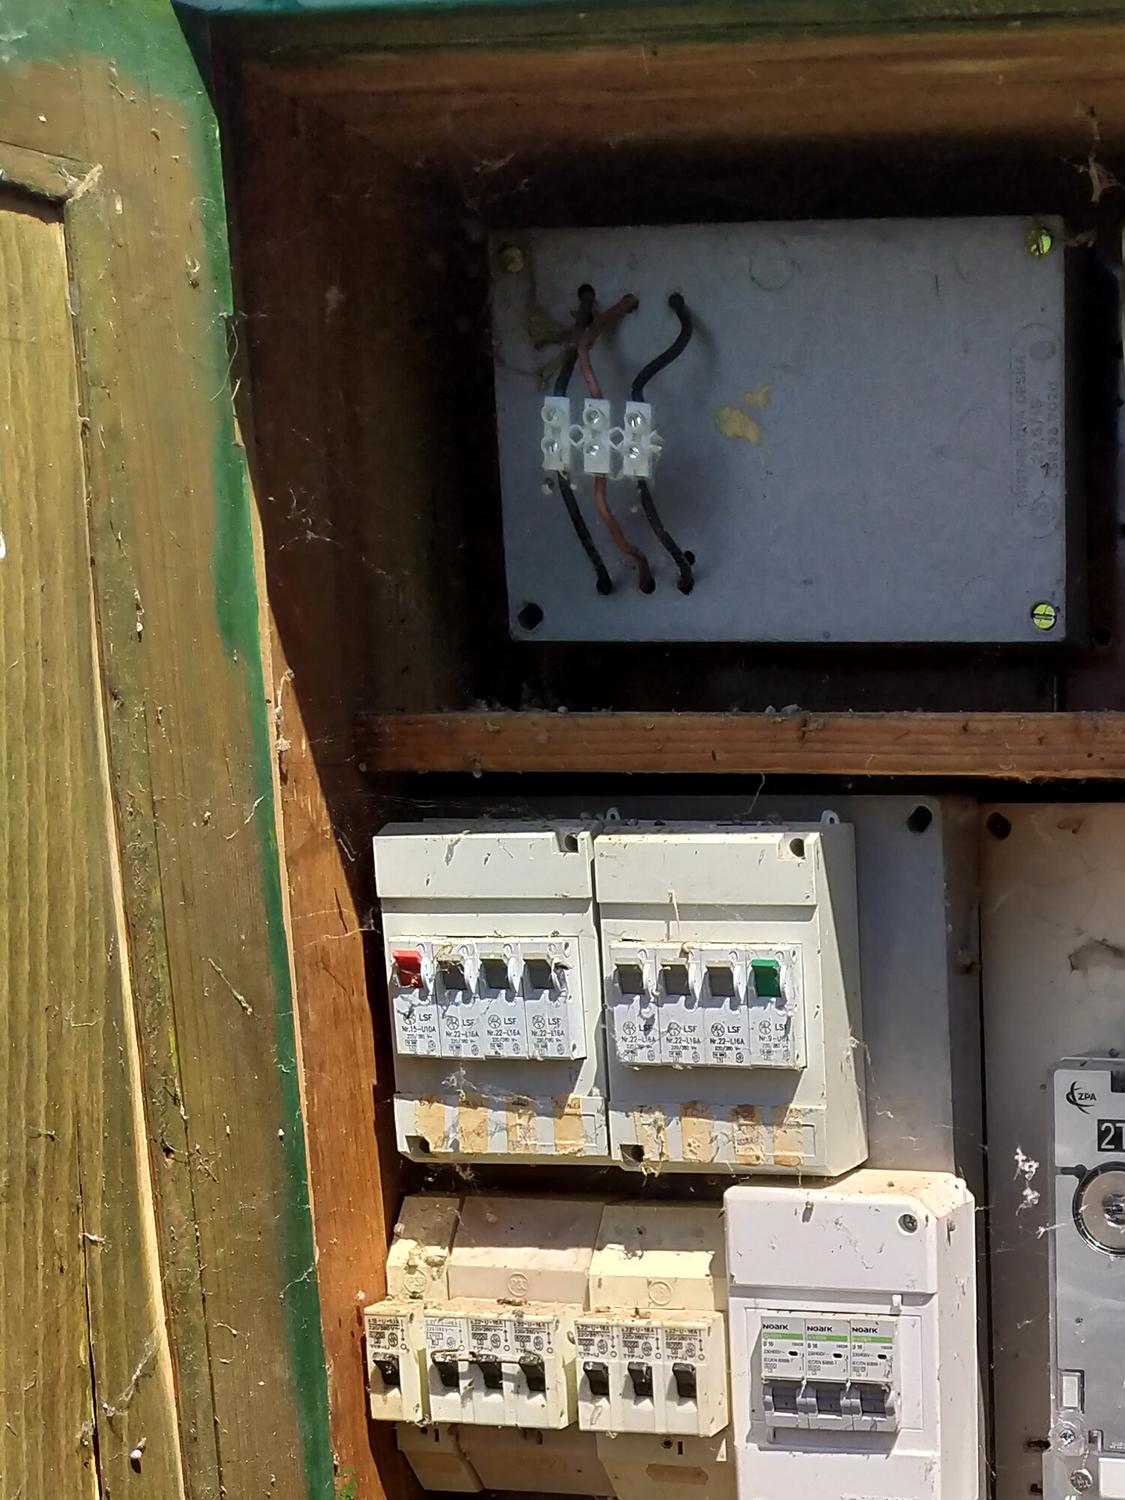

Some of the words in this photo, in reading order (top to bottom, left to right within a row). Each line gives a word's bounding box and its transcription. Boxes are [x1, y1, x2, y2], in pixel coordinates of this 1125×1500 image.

[419, 1013, 433, 1022] LSF
[503, 1017, 517, 1025] LSF
[547, 1017, 561, 1026] LSF
[683, 1025, 697, 1033] LSF
[727, 1026, 741, 1034] LSF
[1078, 1092, 1097, 1101] ZPA
